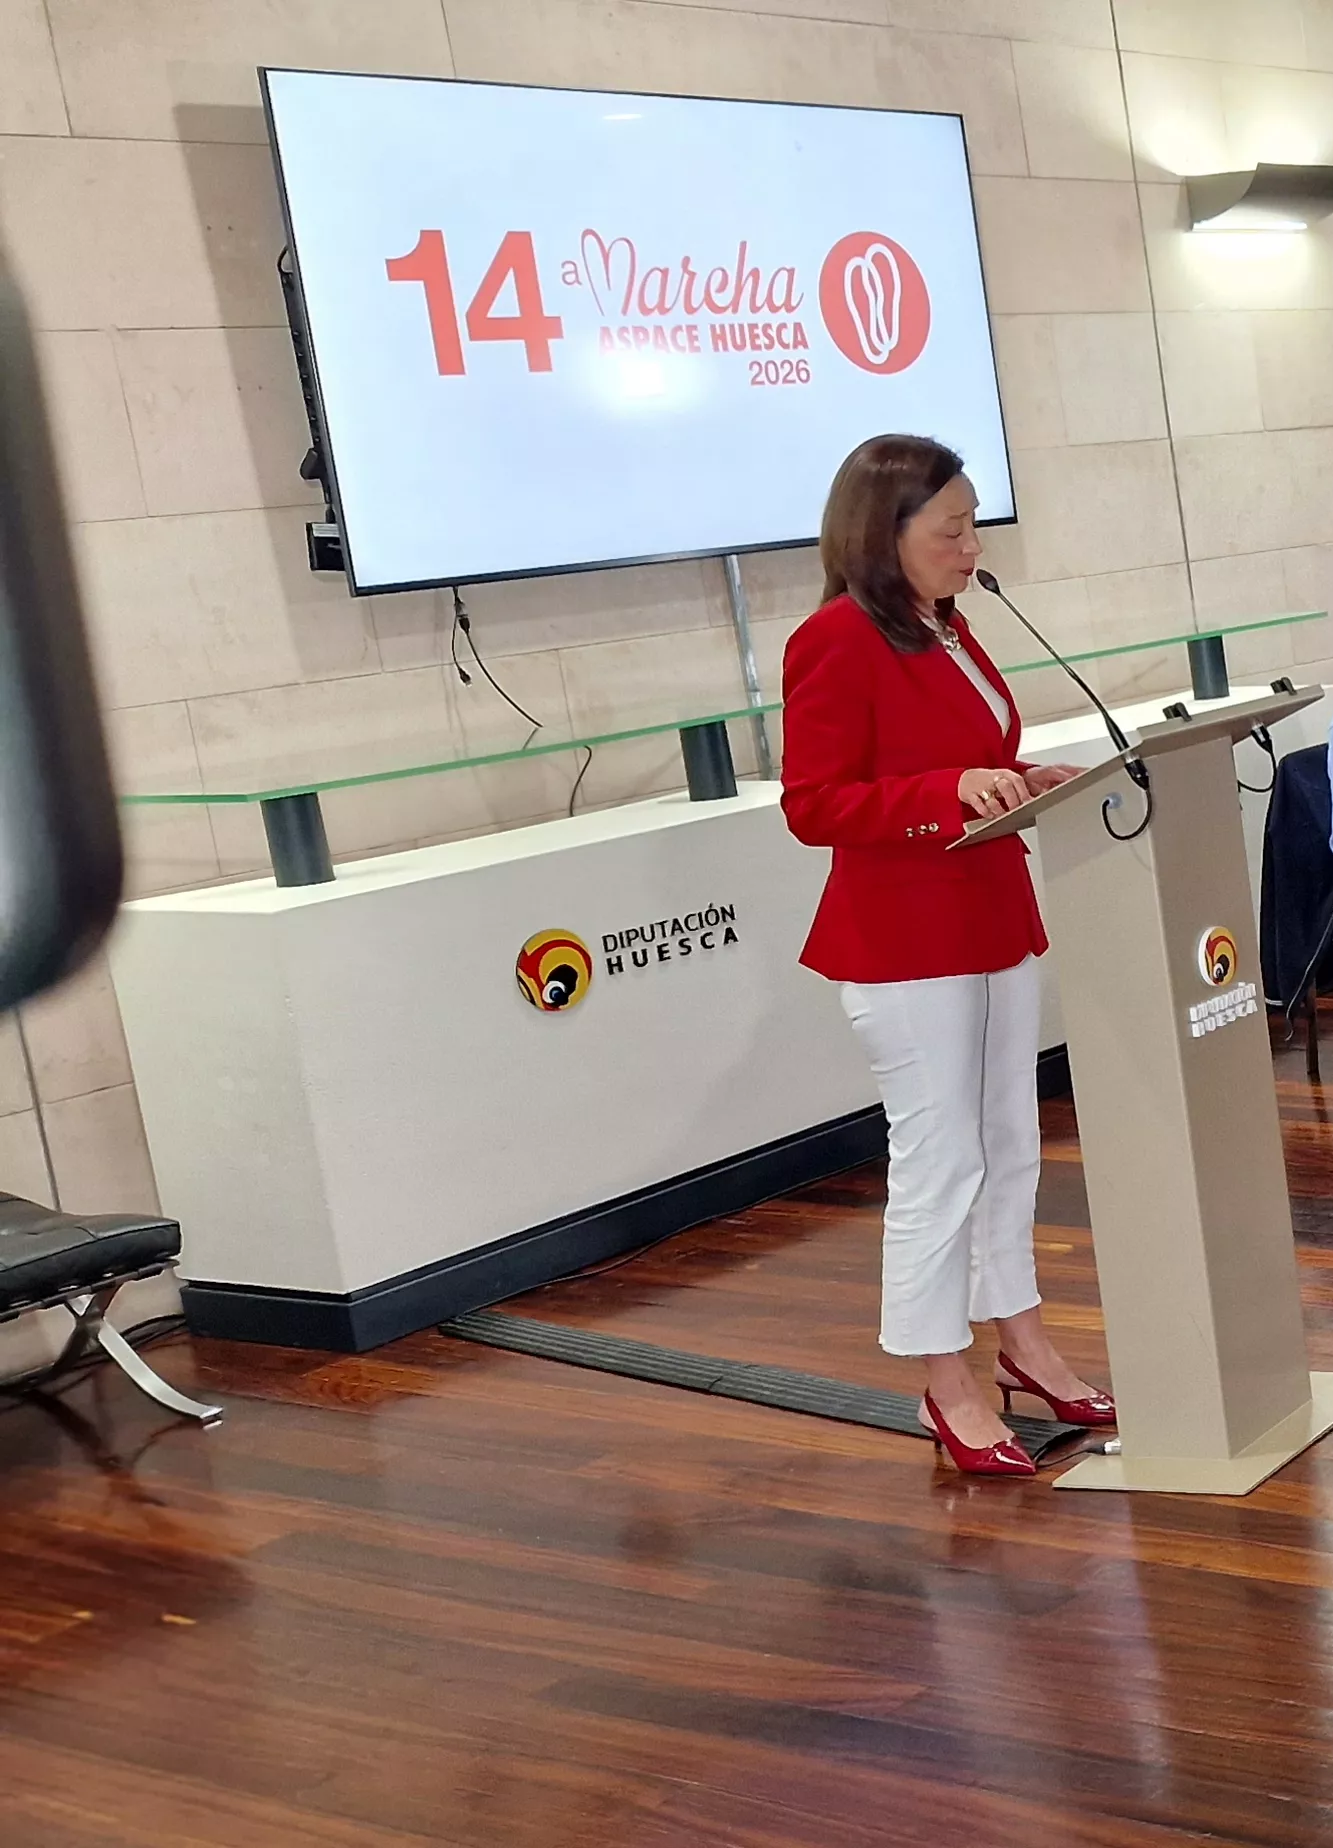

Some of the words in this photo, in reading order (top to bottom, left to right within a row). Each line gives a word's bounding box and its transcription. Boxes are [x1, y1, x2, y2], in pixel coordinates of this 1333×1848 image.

[385, 229, 563, 376] 14
[581, 228, 804, 316] Marcha
[600, 324, 701, 353] ASPACE
[709, 322, 810, 352] HUESCA
[749, 359, 811, 386] 2026
[602, 903, 737, 953] DIPUTACIÓN
[605, 926, 739, 976] HUESCA
